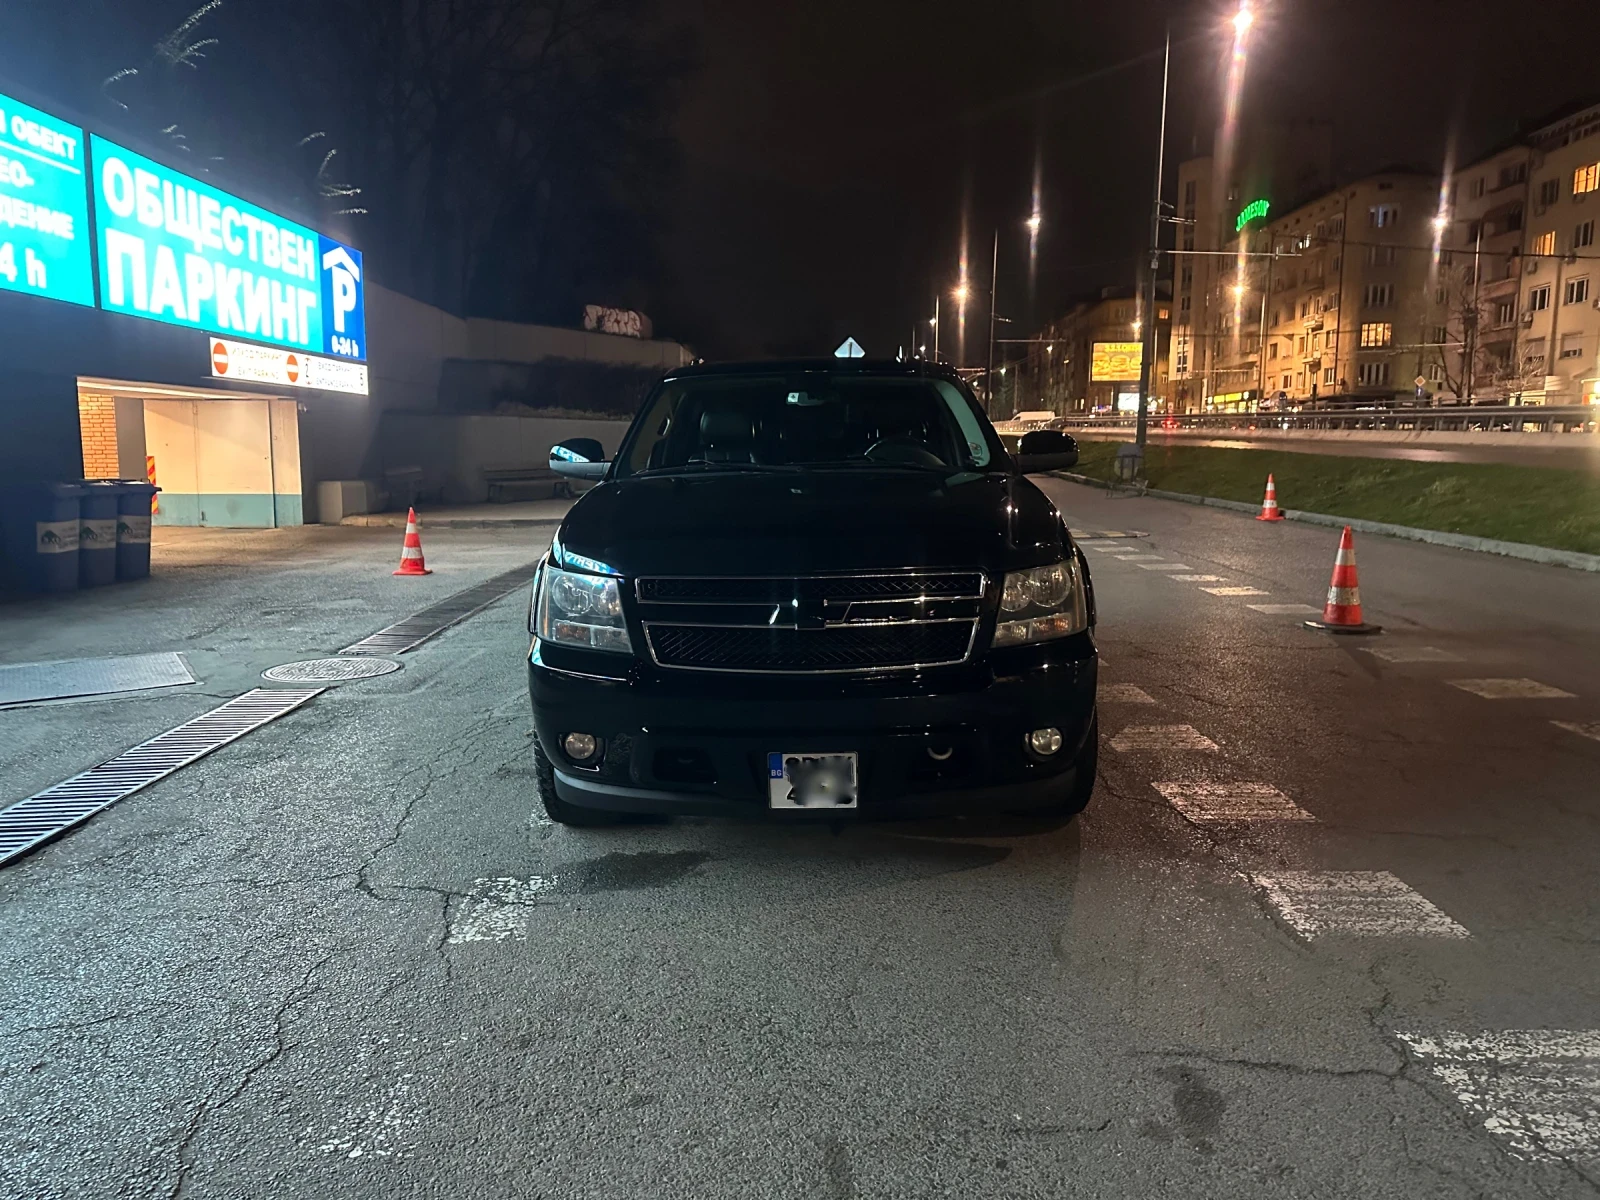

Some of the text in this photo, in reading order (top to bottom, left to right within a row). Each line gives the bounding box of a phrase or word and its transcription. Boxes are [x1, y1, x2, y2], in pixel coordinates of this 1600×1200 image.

[11, 115, 77, 161] ОБЕКТ
[102, 156, 316, 283] ОБЩЕСТВЕН
[25, 247, 47, 289] h
[106, 228, 317, 346] ПАРКИНГ
[331, 334, 360, 358] 0-24 h
[771, 769, 782, 777] BG
